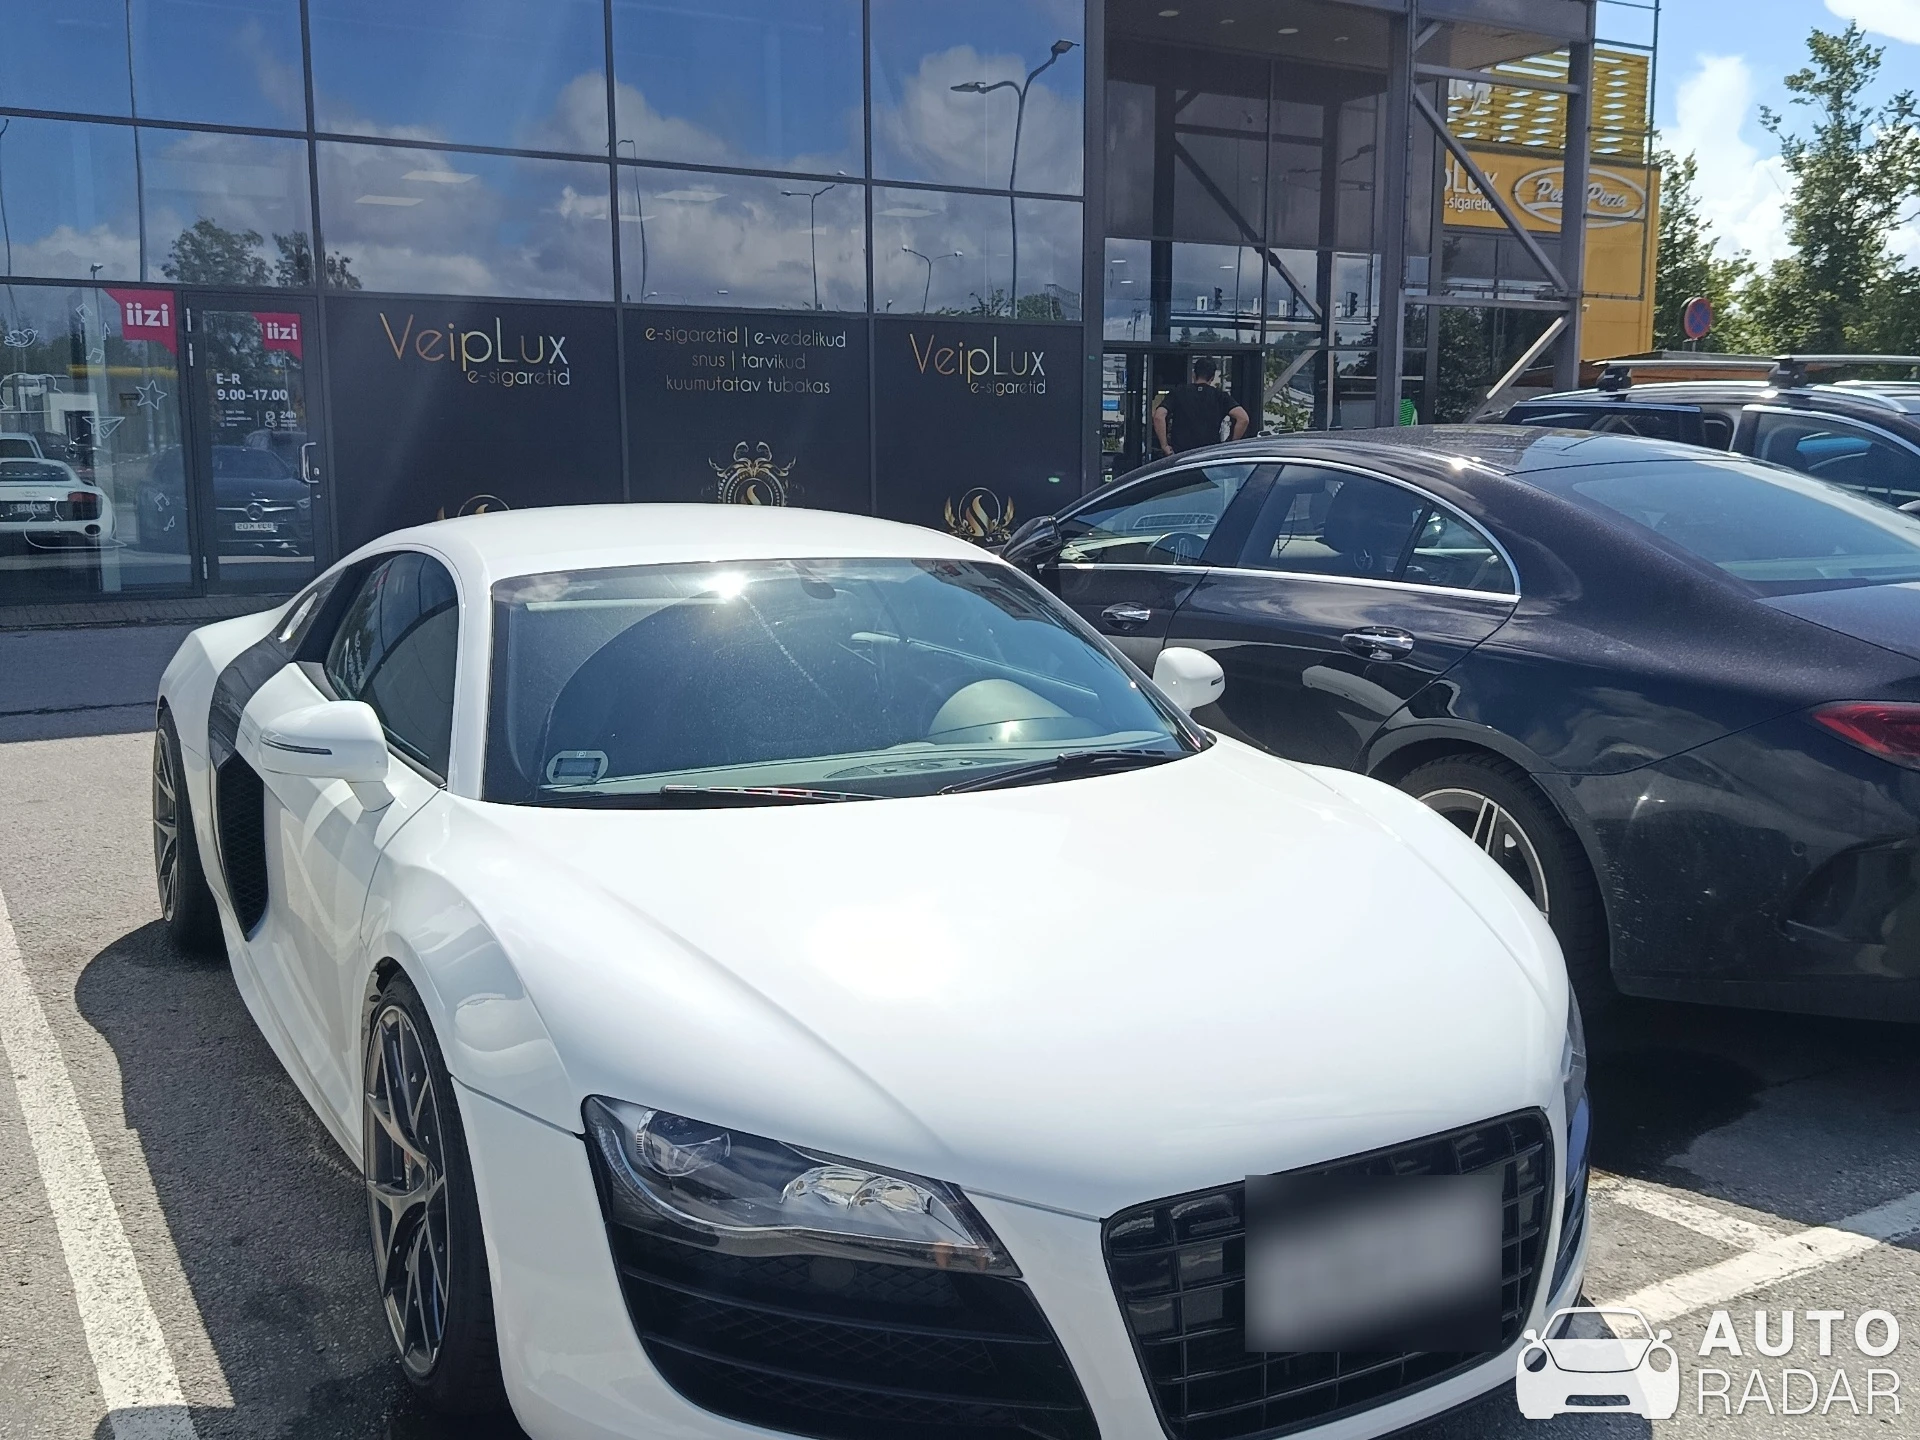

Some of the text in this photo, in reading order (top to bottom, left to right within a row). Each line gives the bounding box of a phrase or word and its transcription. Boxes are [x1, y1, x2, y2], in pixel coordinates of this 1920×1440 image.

[126, 303, 169, 327] iizi
[267, 322, 298, 340] iizi
[645, 326, 738, 345] e-sigaretid
[754, 331, 846, 348] e-vedelikud
[379, 312, 569, 371] VeipLux
[692, 353, 725, 368] snus
[741, 353, 806, 370] tarvikud
[909, 333, 1045, 383] VeipLux
[467, 368, 570, 387] e-sigaretid
[666, 375, 831, 394] kuumutatav tubakas
[970, 379, 1046, 397] e-sigaretid
